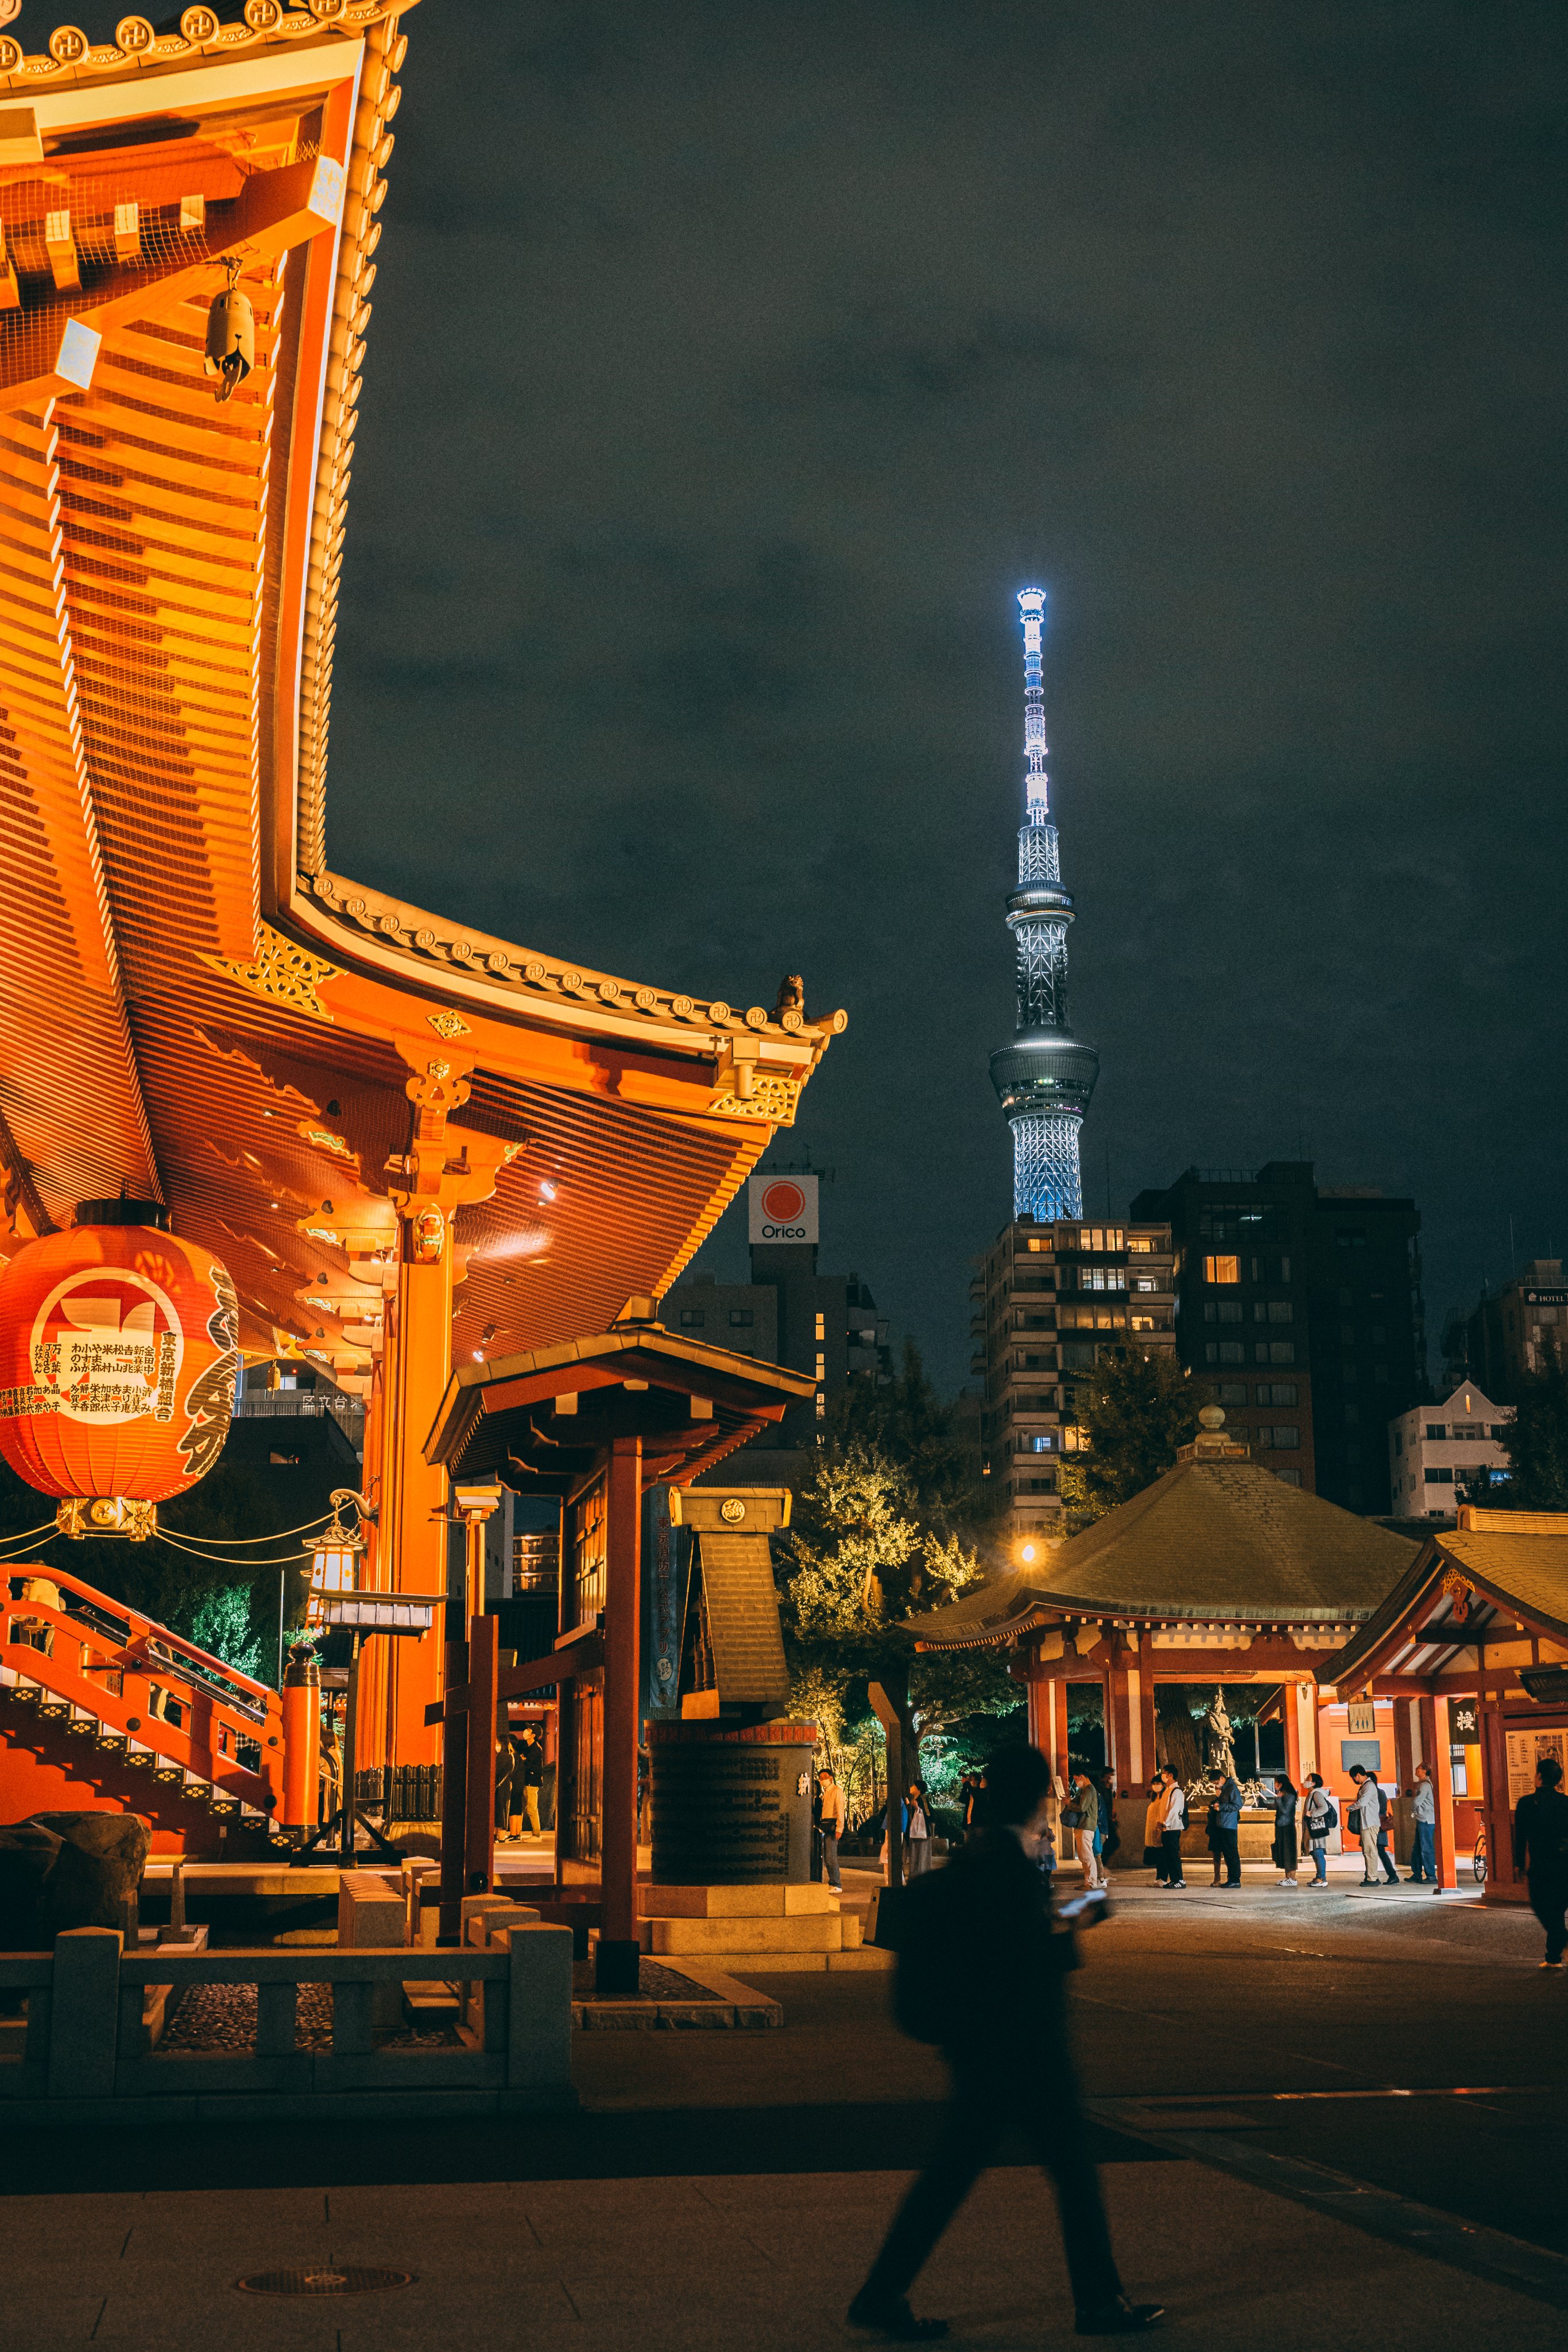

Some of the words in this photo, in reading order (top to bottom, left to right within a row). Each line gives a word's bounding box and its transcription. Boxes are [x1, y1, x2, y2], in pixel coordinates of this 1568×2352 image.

[761, 1225, 806, 1239] Orico
[43, 1344, 52, 1374] Jade
[51, 1343, 61, 1374] 万葉
[81, 1343, 91, 1372] 小すが
[100, 1344, 113, 1373] 米村
[113, 1344, 123, 1372] 松山
[133, 1345, 144, 1374] 新喜楽
[144, 1345, 154, 1375] 金田中
[156, 1332, 176, 1421] 東京新橋組合
[26, 1386, 34, 1413] 君千代
[33, 1386, 42, 1413] 加奈
[42, 1385, 51, 1411] あや
[51, 1384, 60, 1411] 晶子
[90, 1383, 100, 1412] 栄太郎
[100, 1383, 111, 1412] 加津代
[111, 1384, 122, 1413] 杏子
[141, 1386, 153, 1413] 清み
[657, 1517, 671, 1655] 東京消防庁公式アプリ
[1457, 1711, 1474, 1731] 授
